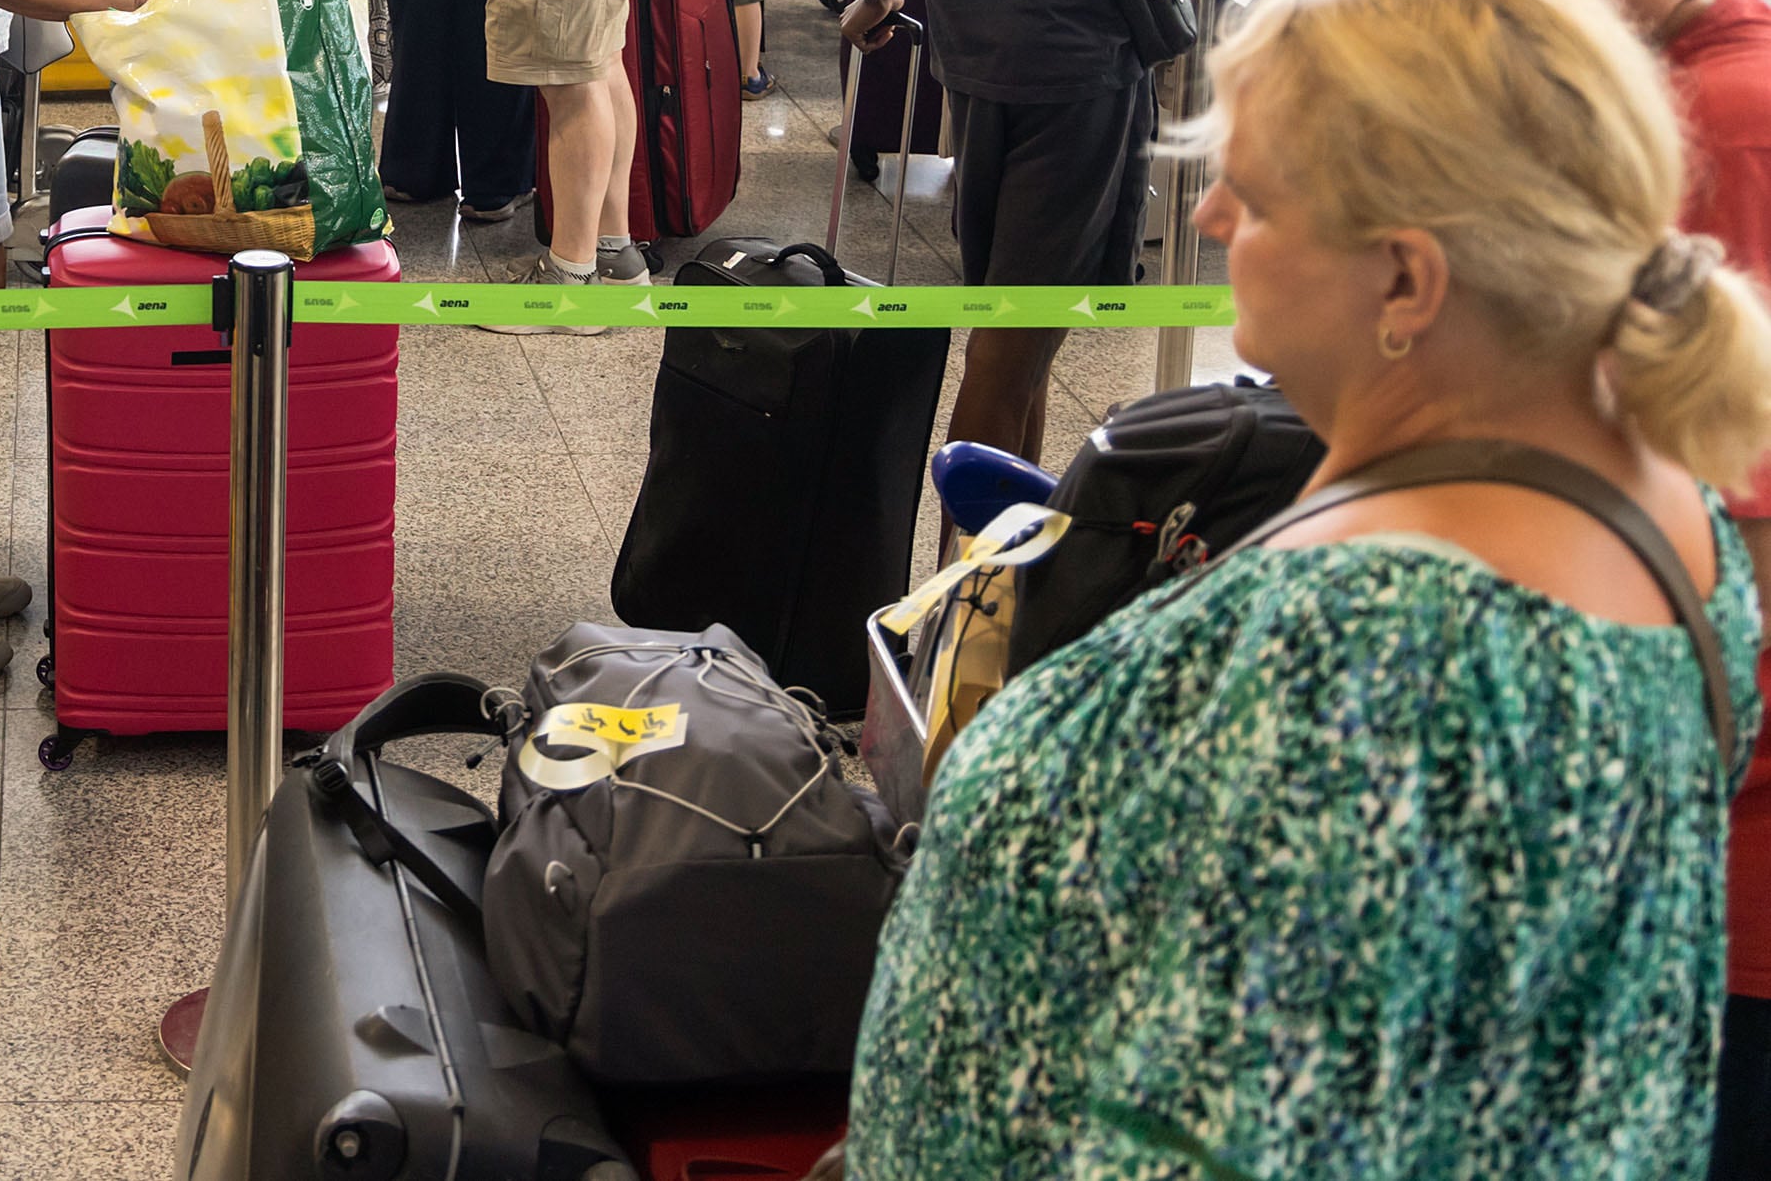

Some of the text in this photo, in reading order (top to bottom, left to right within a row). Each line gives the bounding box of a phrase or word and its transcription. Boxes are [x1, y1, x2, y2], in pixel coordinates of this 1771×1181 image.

[138, 300, 167, 311] aena
[440, 298, 469, 309] aena
[659, 300, 688, 311] aena
[877, 301, 907, 312] aena
[1096, 300, 1126, 311] aena
